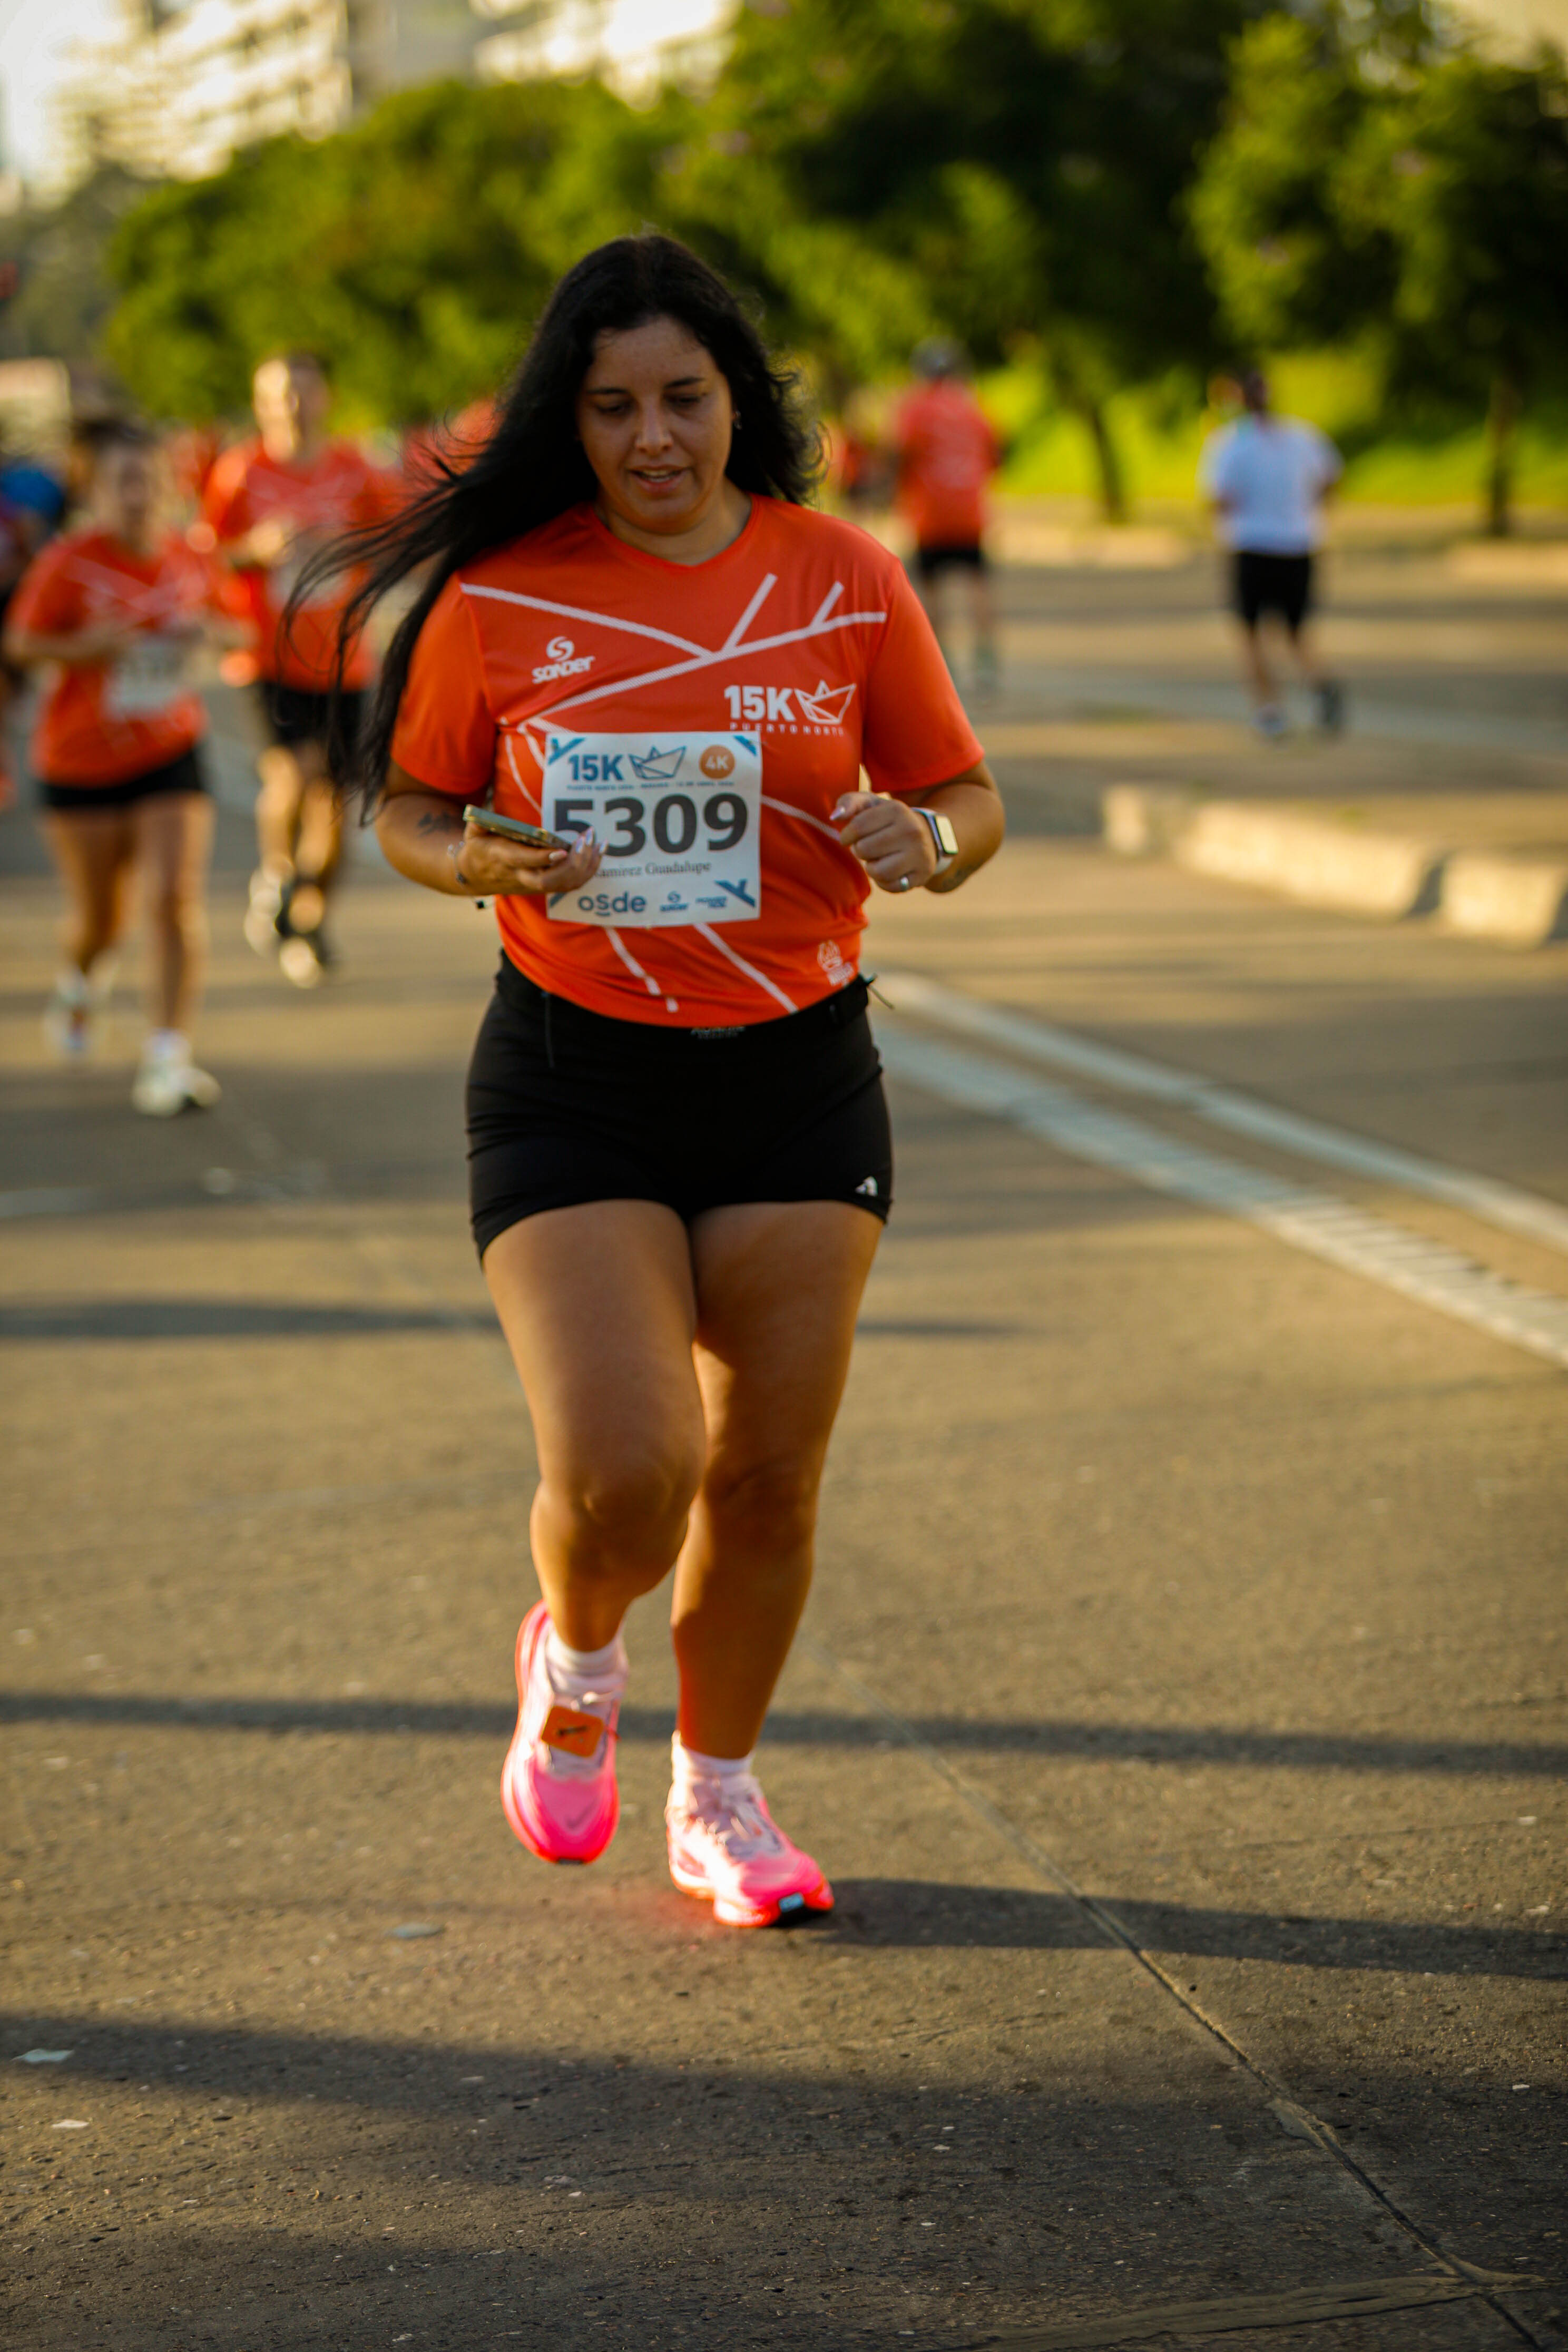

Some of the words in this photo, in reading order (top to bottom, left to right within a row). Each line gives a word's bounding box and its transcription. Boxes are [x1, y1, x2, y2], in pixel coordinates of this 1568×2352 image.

[724, 684, 796, 722] 15K
[729, 722, 798, 733] PUERTO
[569, 753, 624, 781] 15K
[705, 754, 730, 771] 4K
[554, 792, 748, 857] 5309
[595, 866, 642, 878] amirez
[644, 861, 711, 875] Guadalupe
[577, 890, 646, 916] osde
